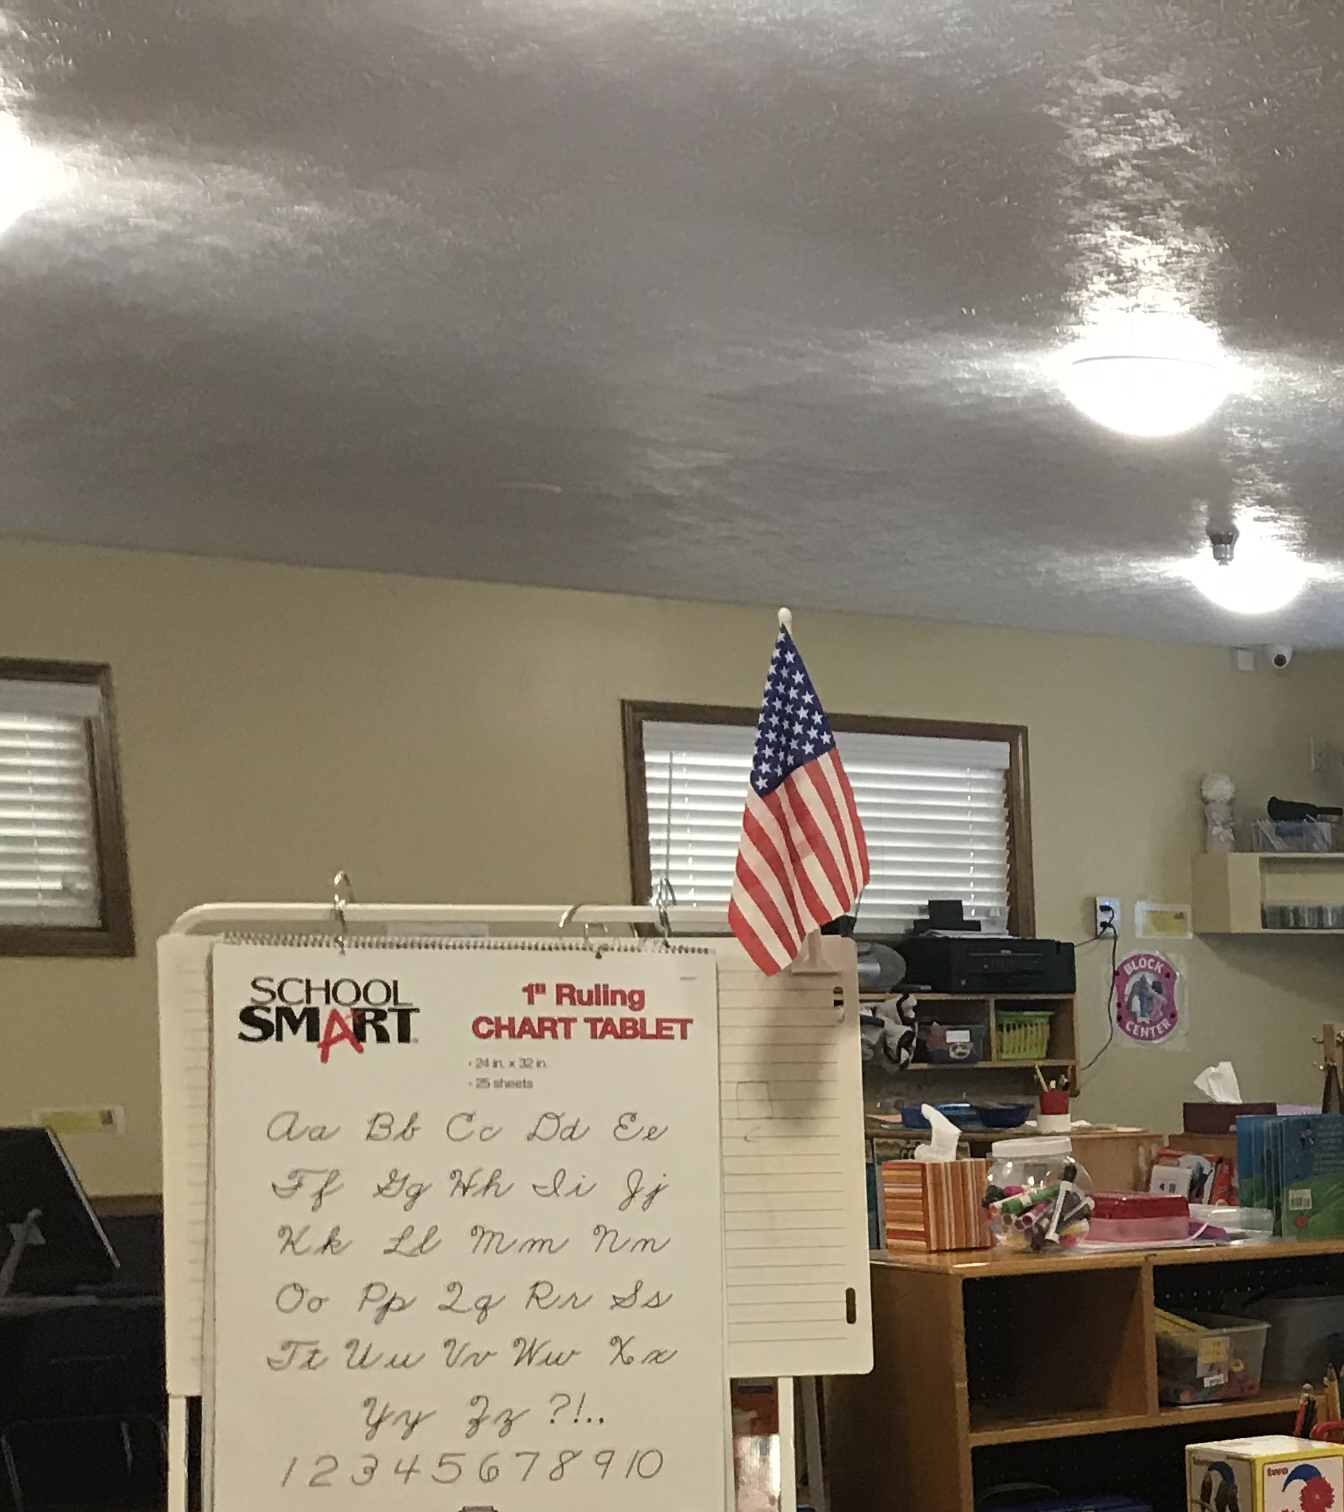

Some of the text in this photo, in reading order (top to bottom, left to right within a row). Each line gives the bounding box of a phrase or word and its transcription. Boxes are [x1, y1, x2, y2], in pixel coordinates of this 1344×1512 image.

[1123, 957, 1165, 975] BLOCK
[250, 976, 413, 1006] SCHOOL
[522, 983, 645, 1012] 1" Ruling
[237, 1006, 420, 1064] SMART
[472, 1016, 694, 1042] CHART TABLET
[1125, 1017, 1172, 1038] CENTER
[475, 1057, 490, 1069] 24
[519, 1057, 534, 1069] 32
[475, 1077, 534, 1090] 25 sheets
[280, 1448, 664, 1488] 1 2 3 4 5 6 7 8 9 10
[1267, 1466, 1289, 1476] two
